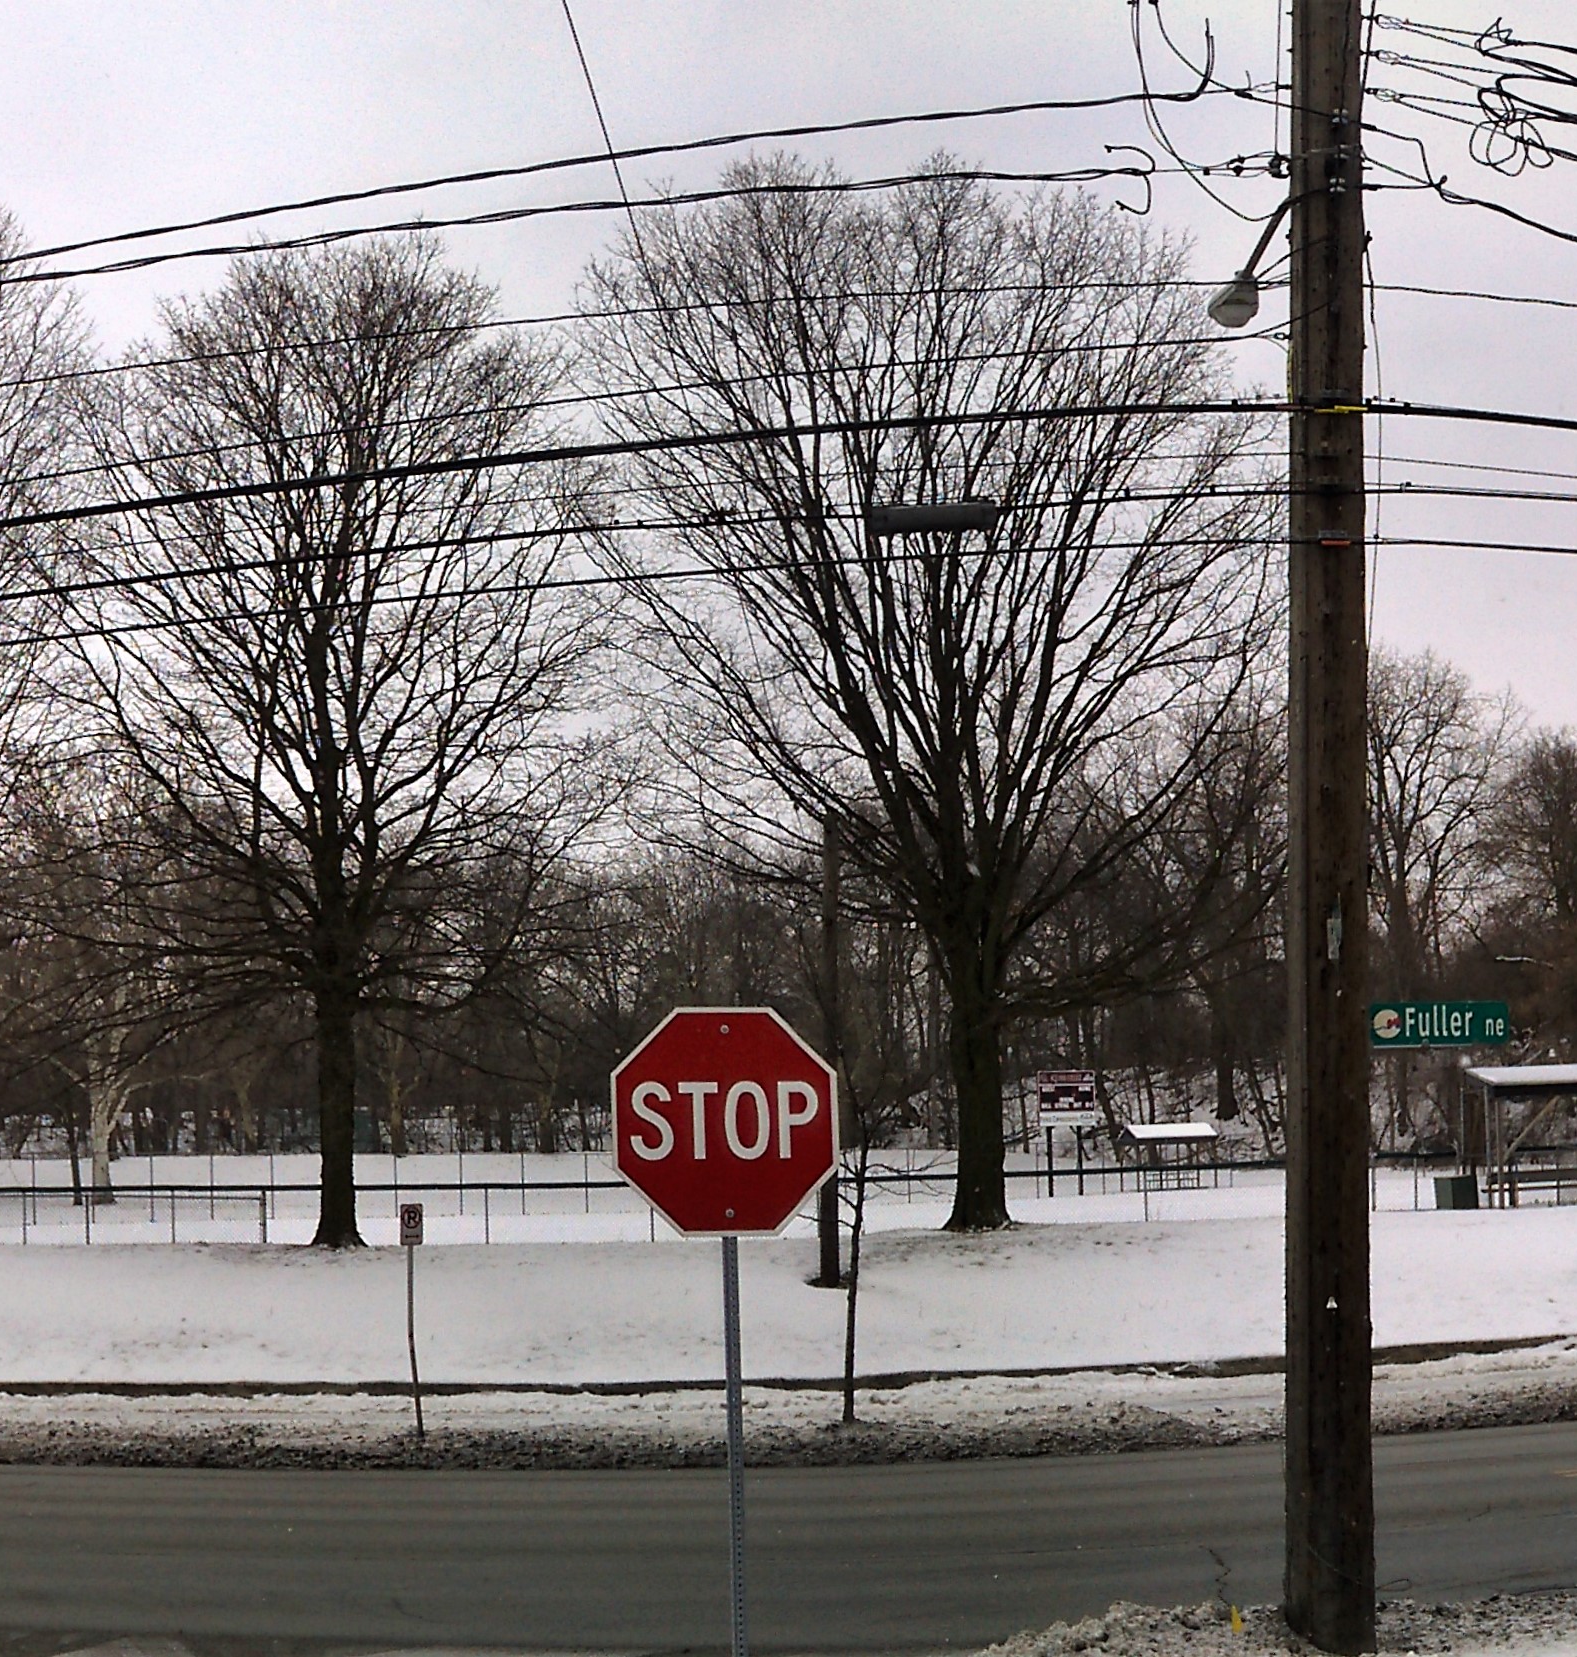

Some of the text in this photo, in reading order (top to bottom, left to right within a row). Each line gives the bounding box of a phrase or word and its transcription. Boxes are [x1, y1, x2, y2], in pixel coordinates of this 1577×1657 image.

[1405, 1004, 1504, 1038] Fuller ne
[629, 1080, 819, 1162] STOP
